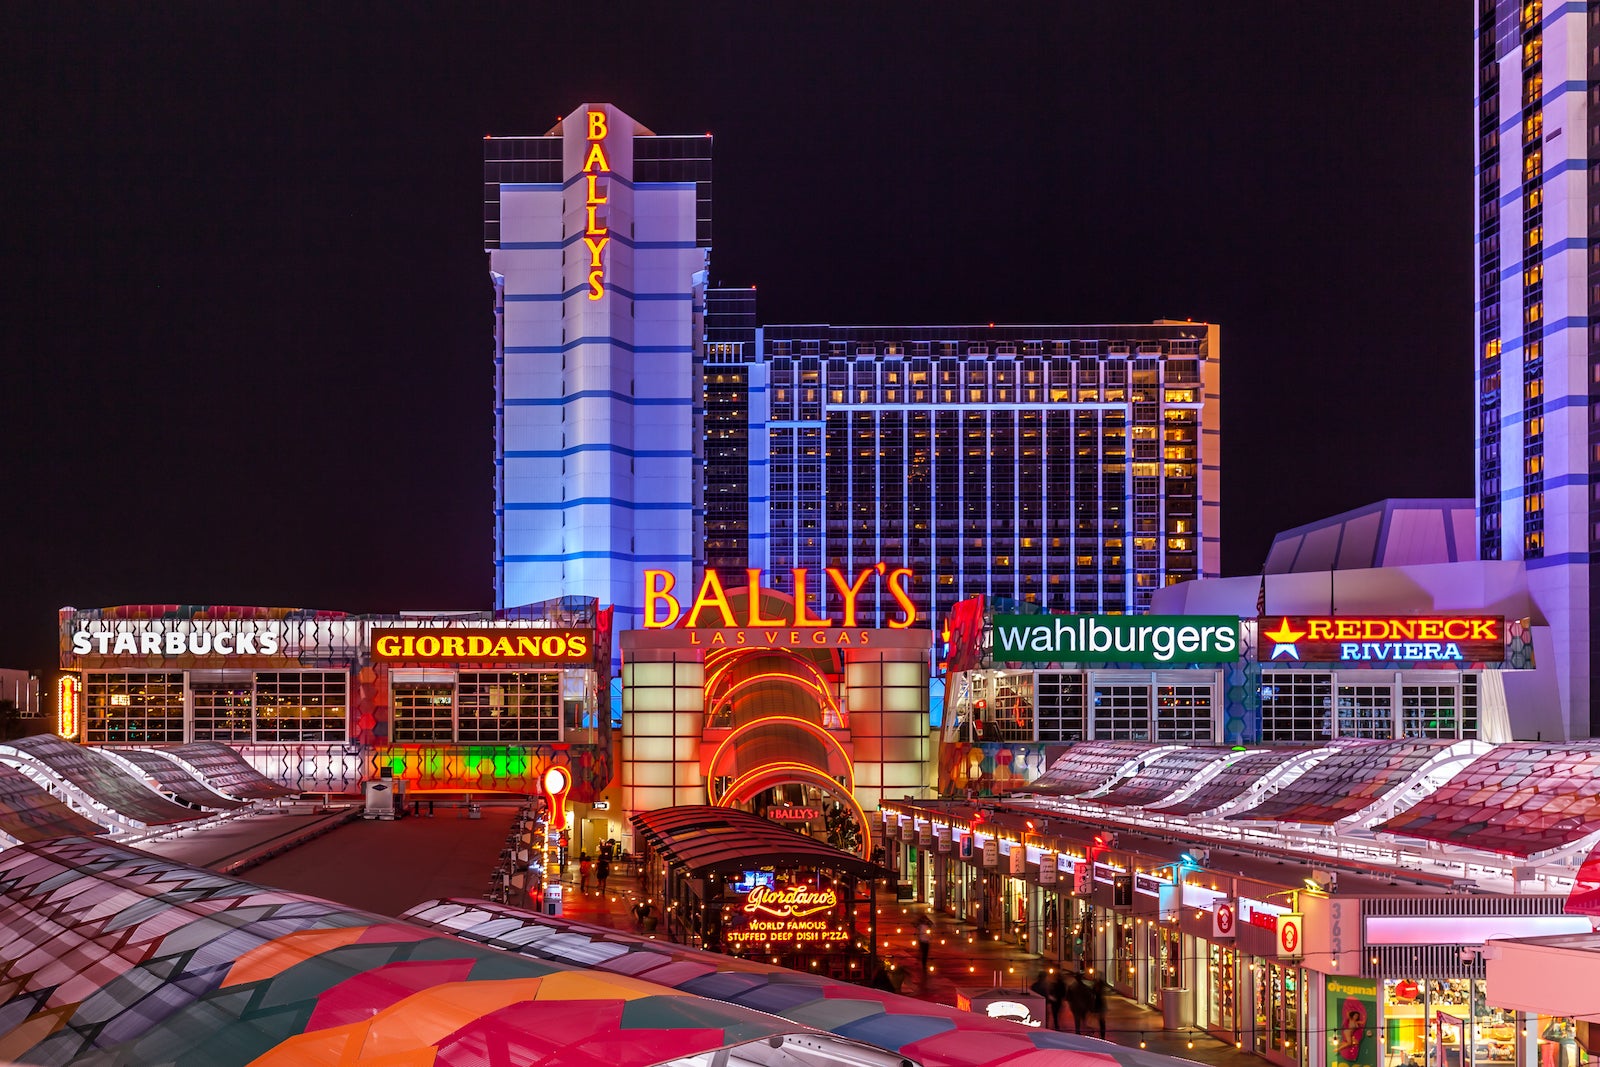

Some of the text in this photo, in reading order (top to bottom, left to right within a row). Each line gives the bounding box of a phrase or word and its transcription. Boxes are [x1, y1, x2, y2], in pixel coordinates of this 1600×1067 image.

[643, 562, 917, 629] BALLY'S
[690, 630, 870, 645] LAS VEGAS
[998, 618, 1236, 661] wahlburgers
[1307, 619, 1498, 640] REDNECK
[73, 631, 279, 655] STARBUCKS
[376, 633, 587, 657] GIORDANO'S
[1341, 643, 1463, 661] RIVIERA
[775, 808, 813, 819] BALLY'S
[744, 885, 837, 916] Giordano's
[727, 932, 767, 941] STUFFED
[770, 932, 793, 941] DEEP
[796, 932, 819, 941] DISH
[749, 921, 827, 931] WORLD FAMOUS
